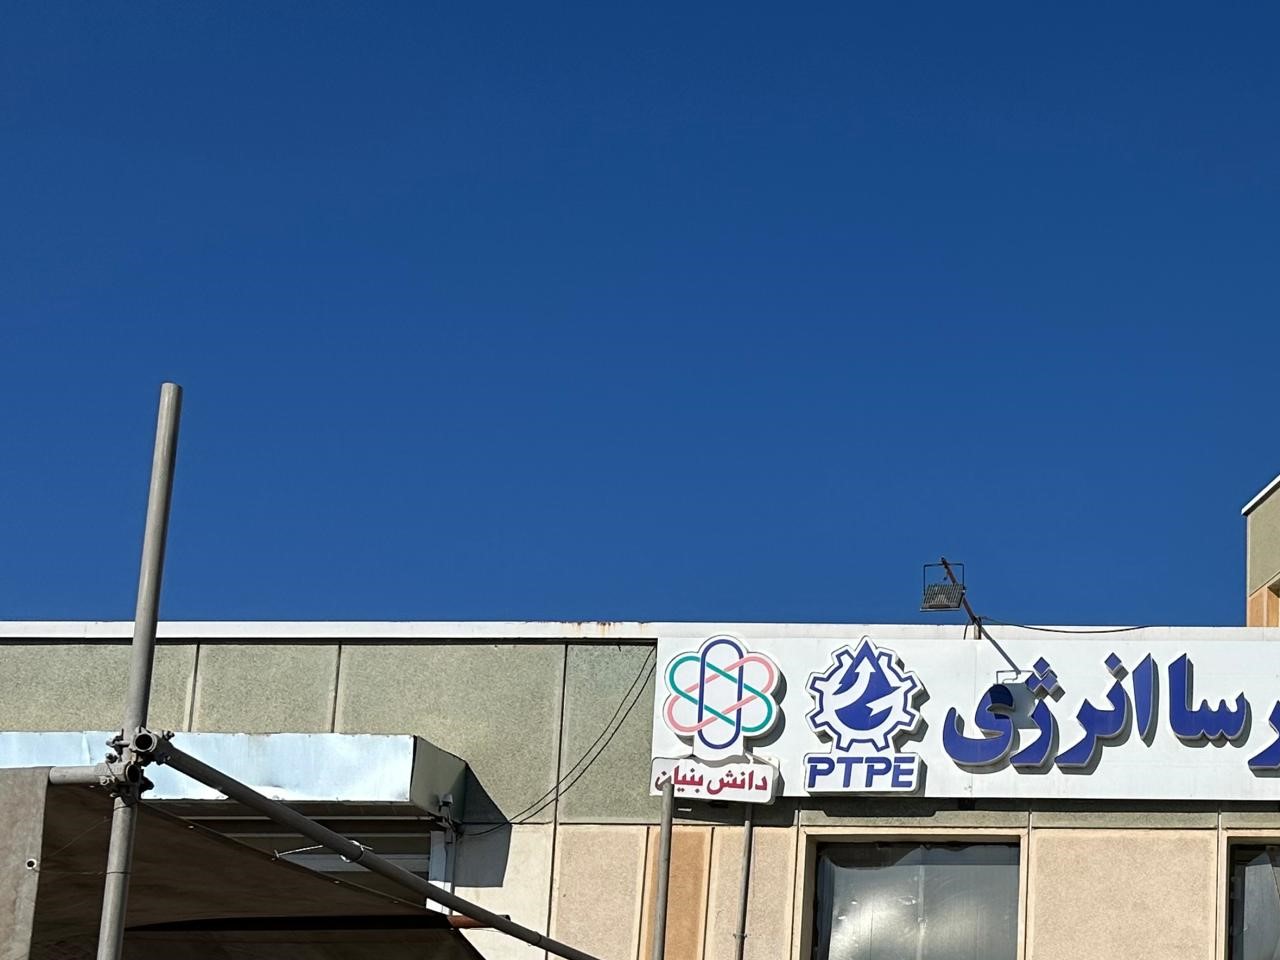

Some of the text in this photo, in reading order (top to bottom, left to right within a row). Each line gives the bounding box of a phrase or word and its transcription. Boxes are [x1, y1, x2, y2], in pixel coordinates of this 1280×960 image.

[943, 652, 1152, 766] انرژی
[706, 769, 768, 795] دانش
[807, 756, 915, 788] PTPE
